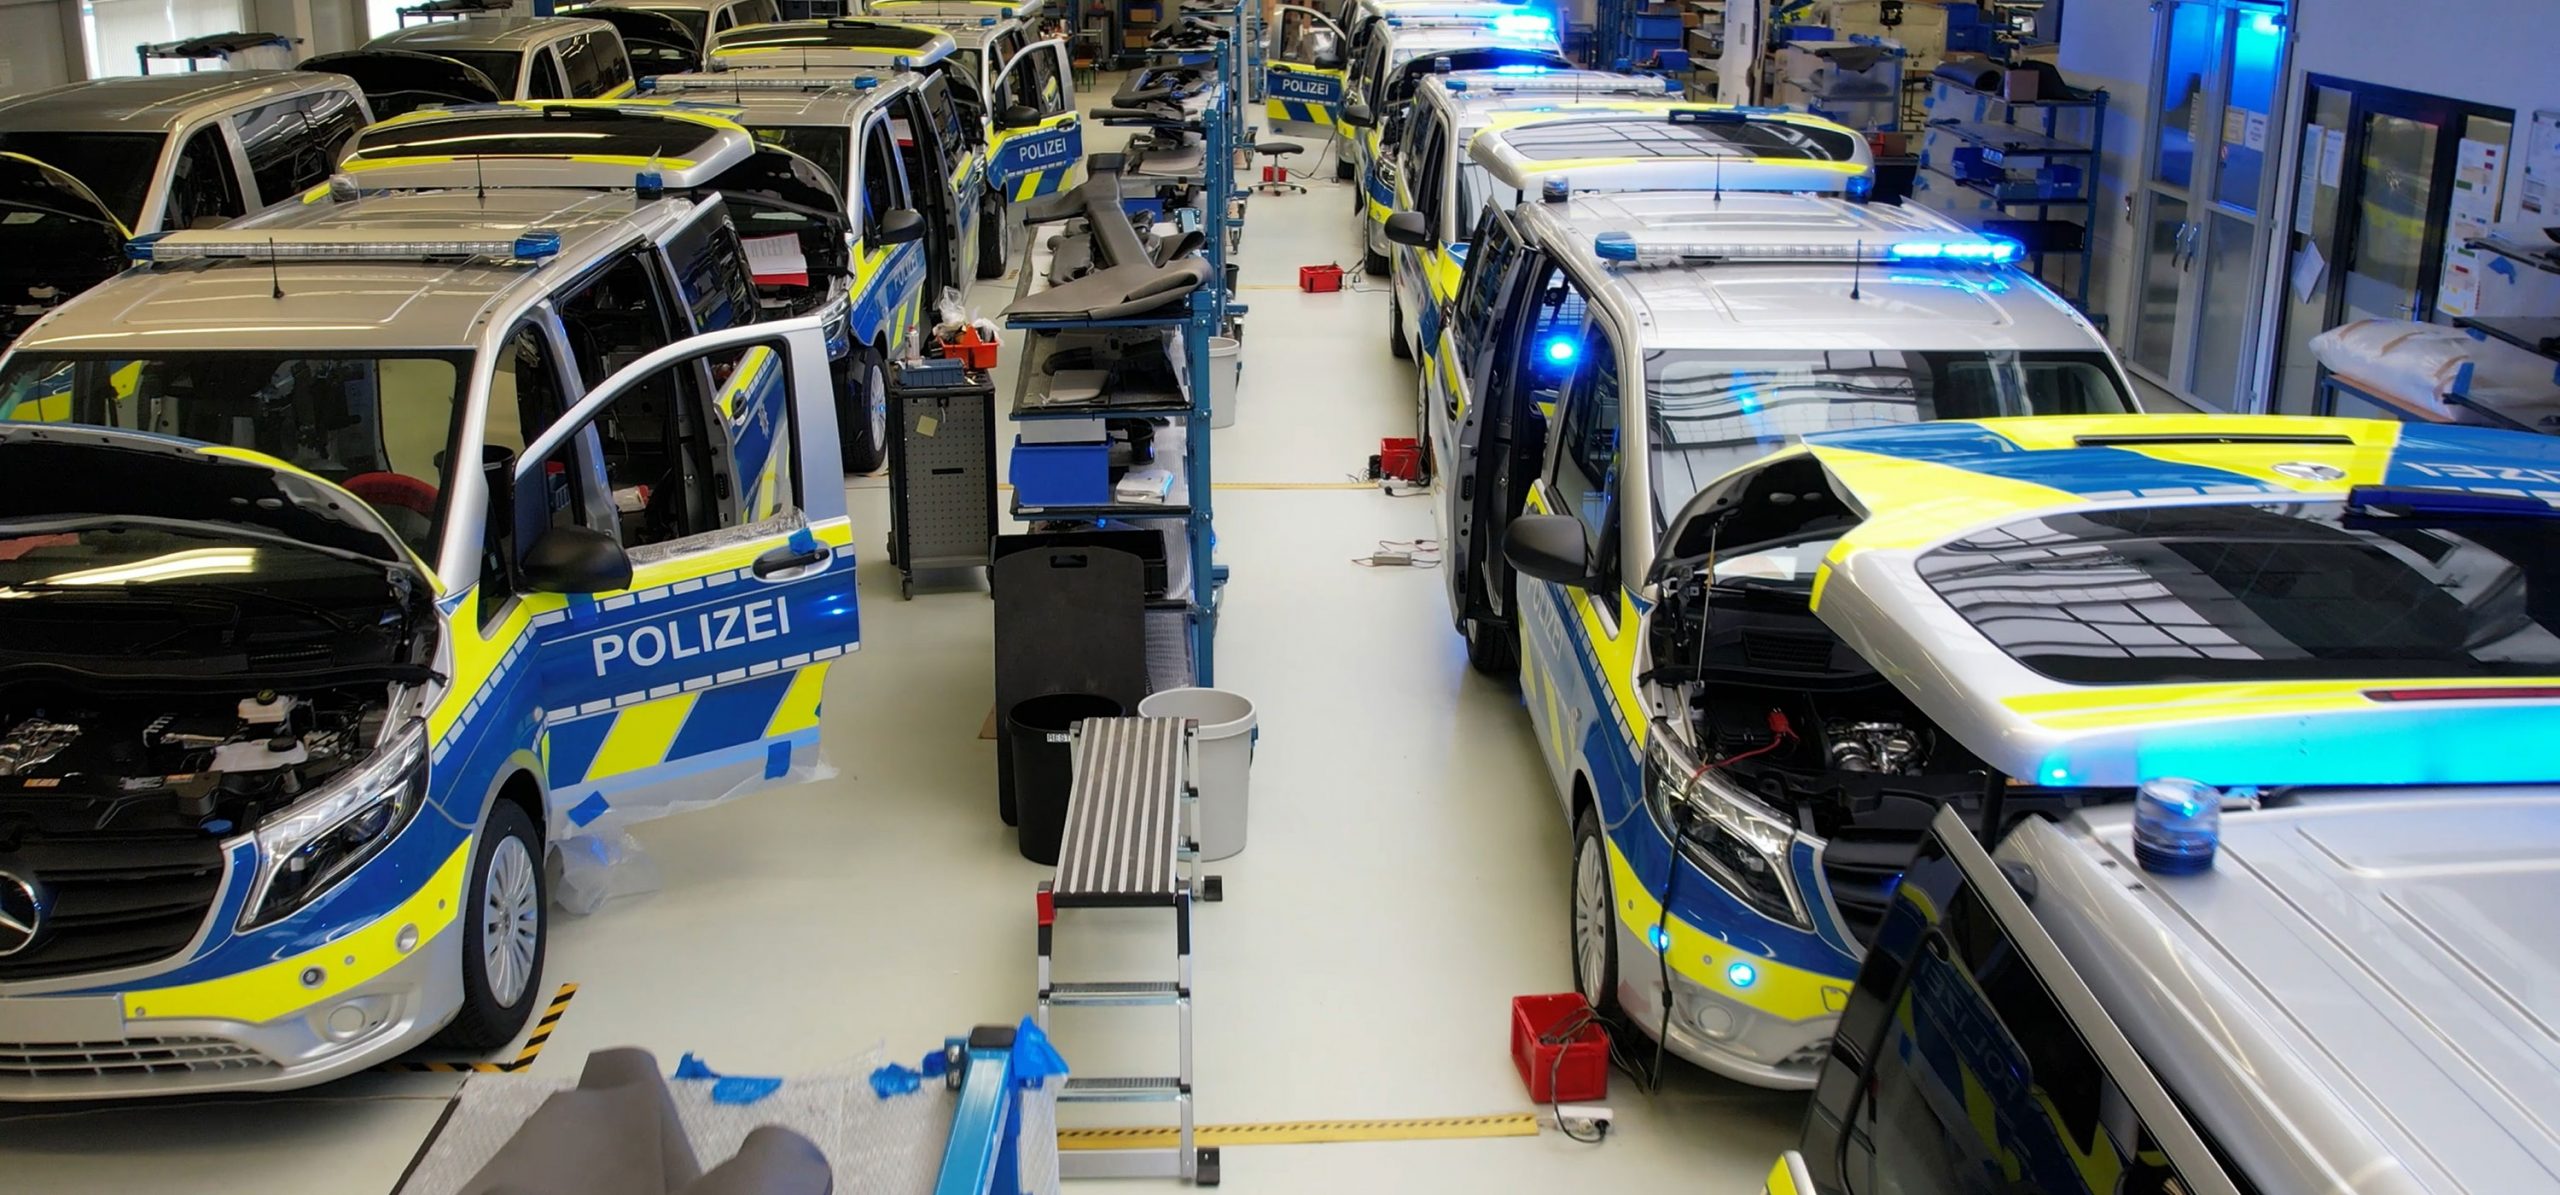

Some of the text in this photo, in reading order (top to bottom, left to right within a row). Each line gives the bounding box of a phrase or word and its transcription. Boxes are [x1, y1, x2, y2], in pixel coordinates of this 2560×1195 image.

[1282, 79, 1329, 96] POLIZEI
[1019, 138, 1067, 162] POLIZEI
[2402, 462, 2560, 483] IZEI
[592, 596, 790, 677] POLIZEI
